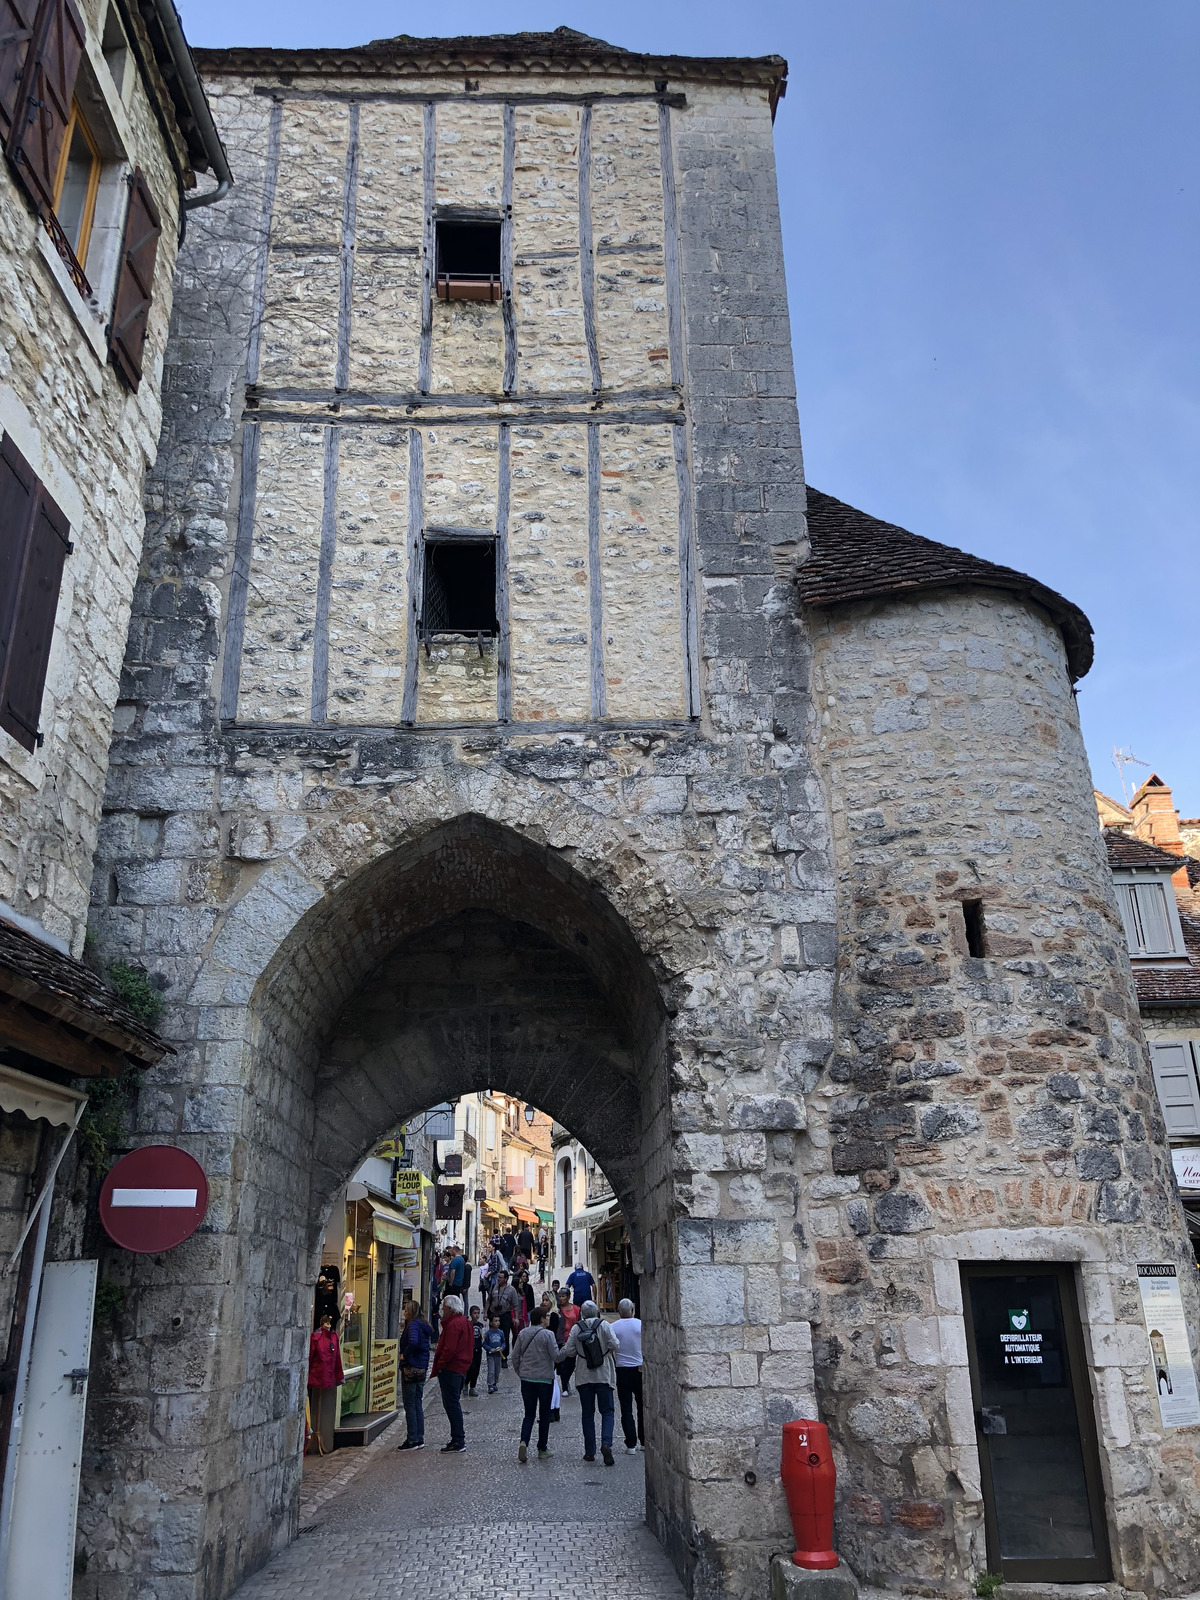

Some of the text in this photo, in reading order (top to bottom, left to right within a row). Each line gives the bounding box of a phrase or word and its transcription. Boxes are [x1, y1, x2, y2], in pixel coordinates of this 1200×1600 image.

[398, 1173, 420, 1182] FAIM
[402, 1182, 420, 1190] LOUP
[1137, 1266, 1176, 1275] ROCAMADOUR
[1000, 1333, 1043, 1342] DEFIBRILLATEUR
[384, 1344, 397, 1354] KEBAB
[1005, 1344, 1040, 1353] AUTOMATIQUE
[1004, 1355, 1043, 1364] A L'INTERIEUR
[798, 1434, 808, 1447] 2
